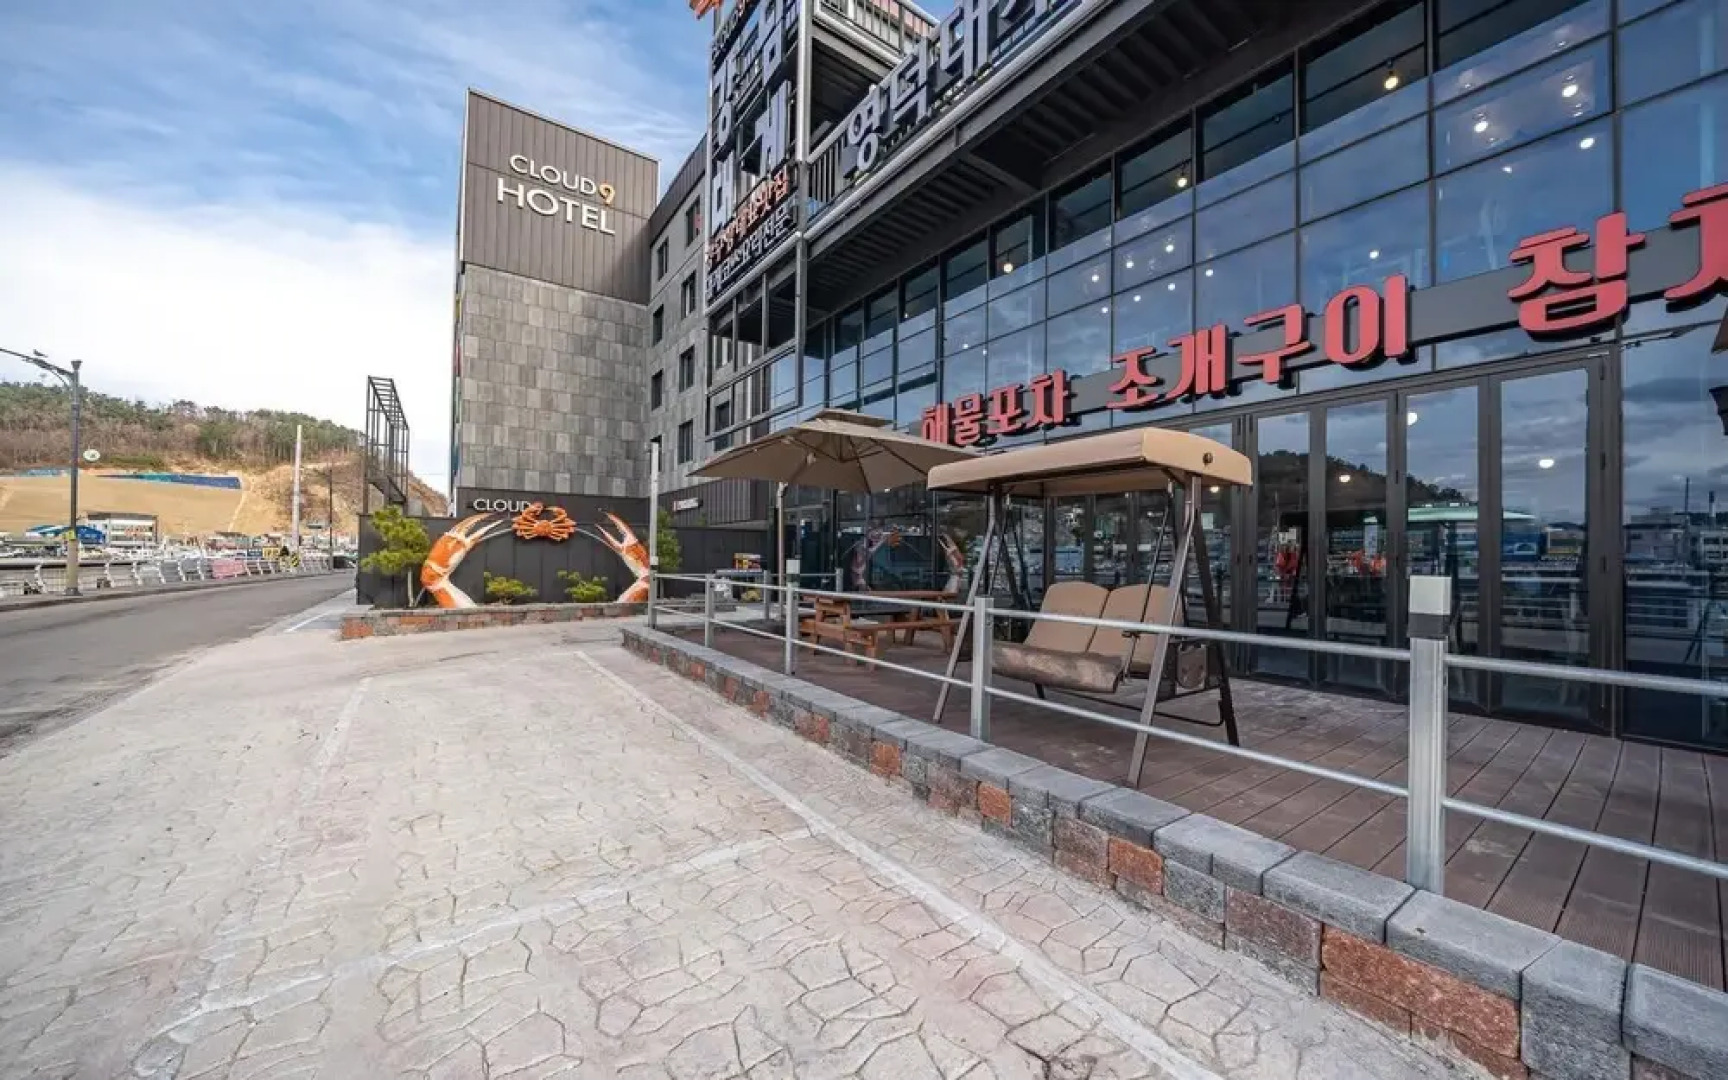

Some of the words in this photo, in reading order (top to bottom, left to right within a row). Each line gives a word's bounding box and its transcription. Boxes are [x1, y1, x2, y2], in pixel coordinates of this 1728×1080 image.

[497, 177, 616, 236] HOTEL
[921, 367, 1069, 445] 해물포차
[1106, 273, 1406, 410] 조개구이
